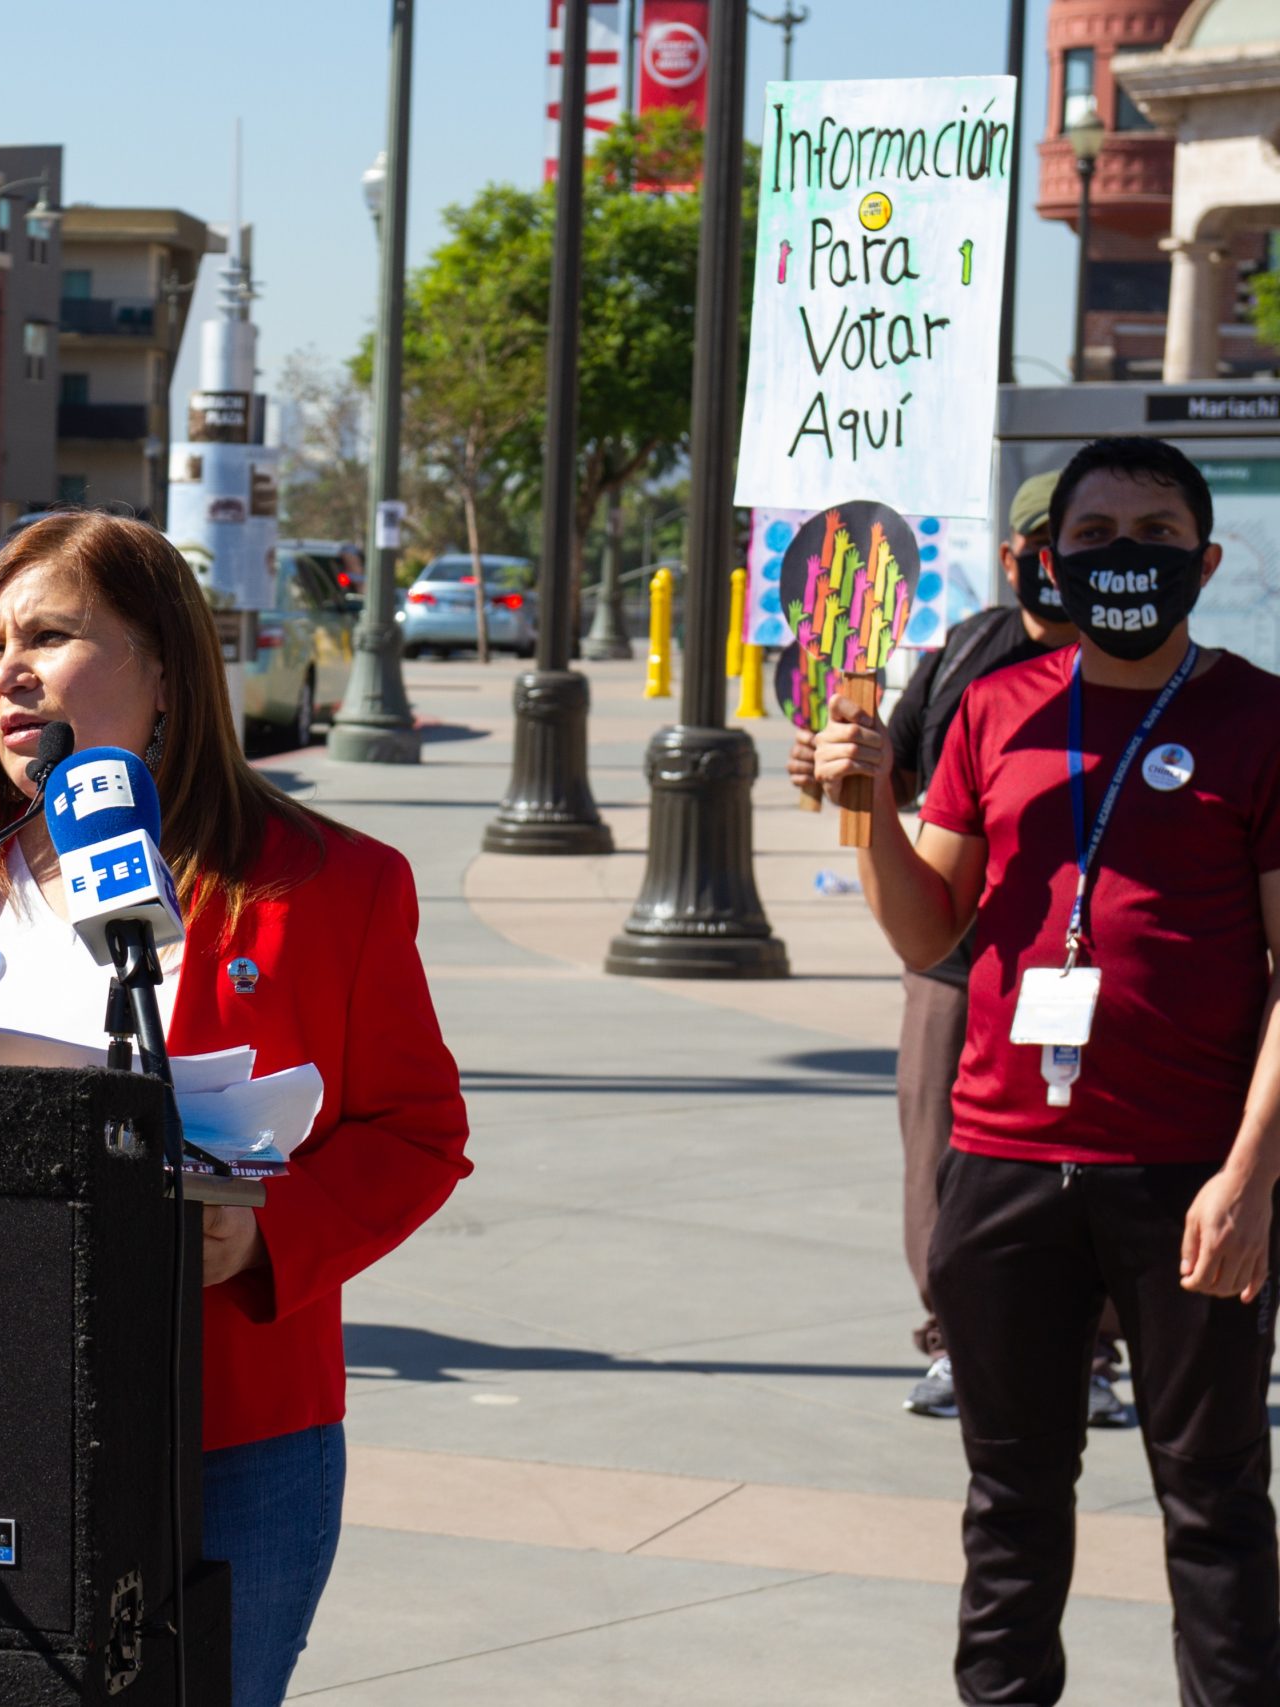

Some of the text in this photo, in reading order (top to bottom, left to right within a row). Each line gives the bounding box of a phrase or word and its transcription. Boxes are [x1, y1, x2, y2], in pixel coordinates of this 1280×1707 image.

[772, 97, 1009, 192] Información
[810, 217, 920, 290] Para
[799, 305, 950, 376] Votar
[788, 391, 912, 461] Aquí
[1091, 603, 1158, 631] 2020
